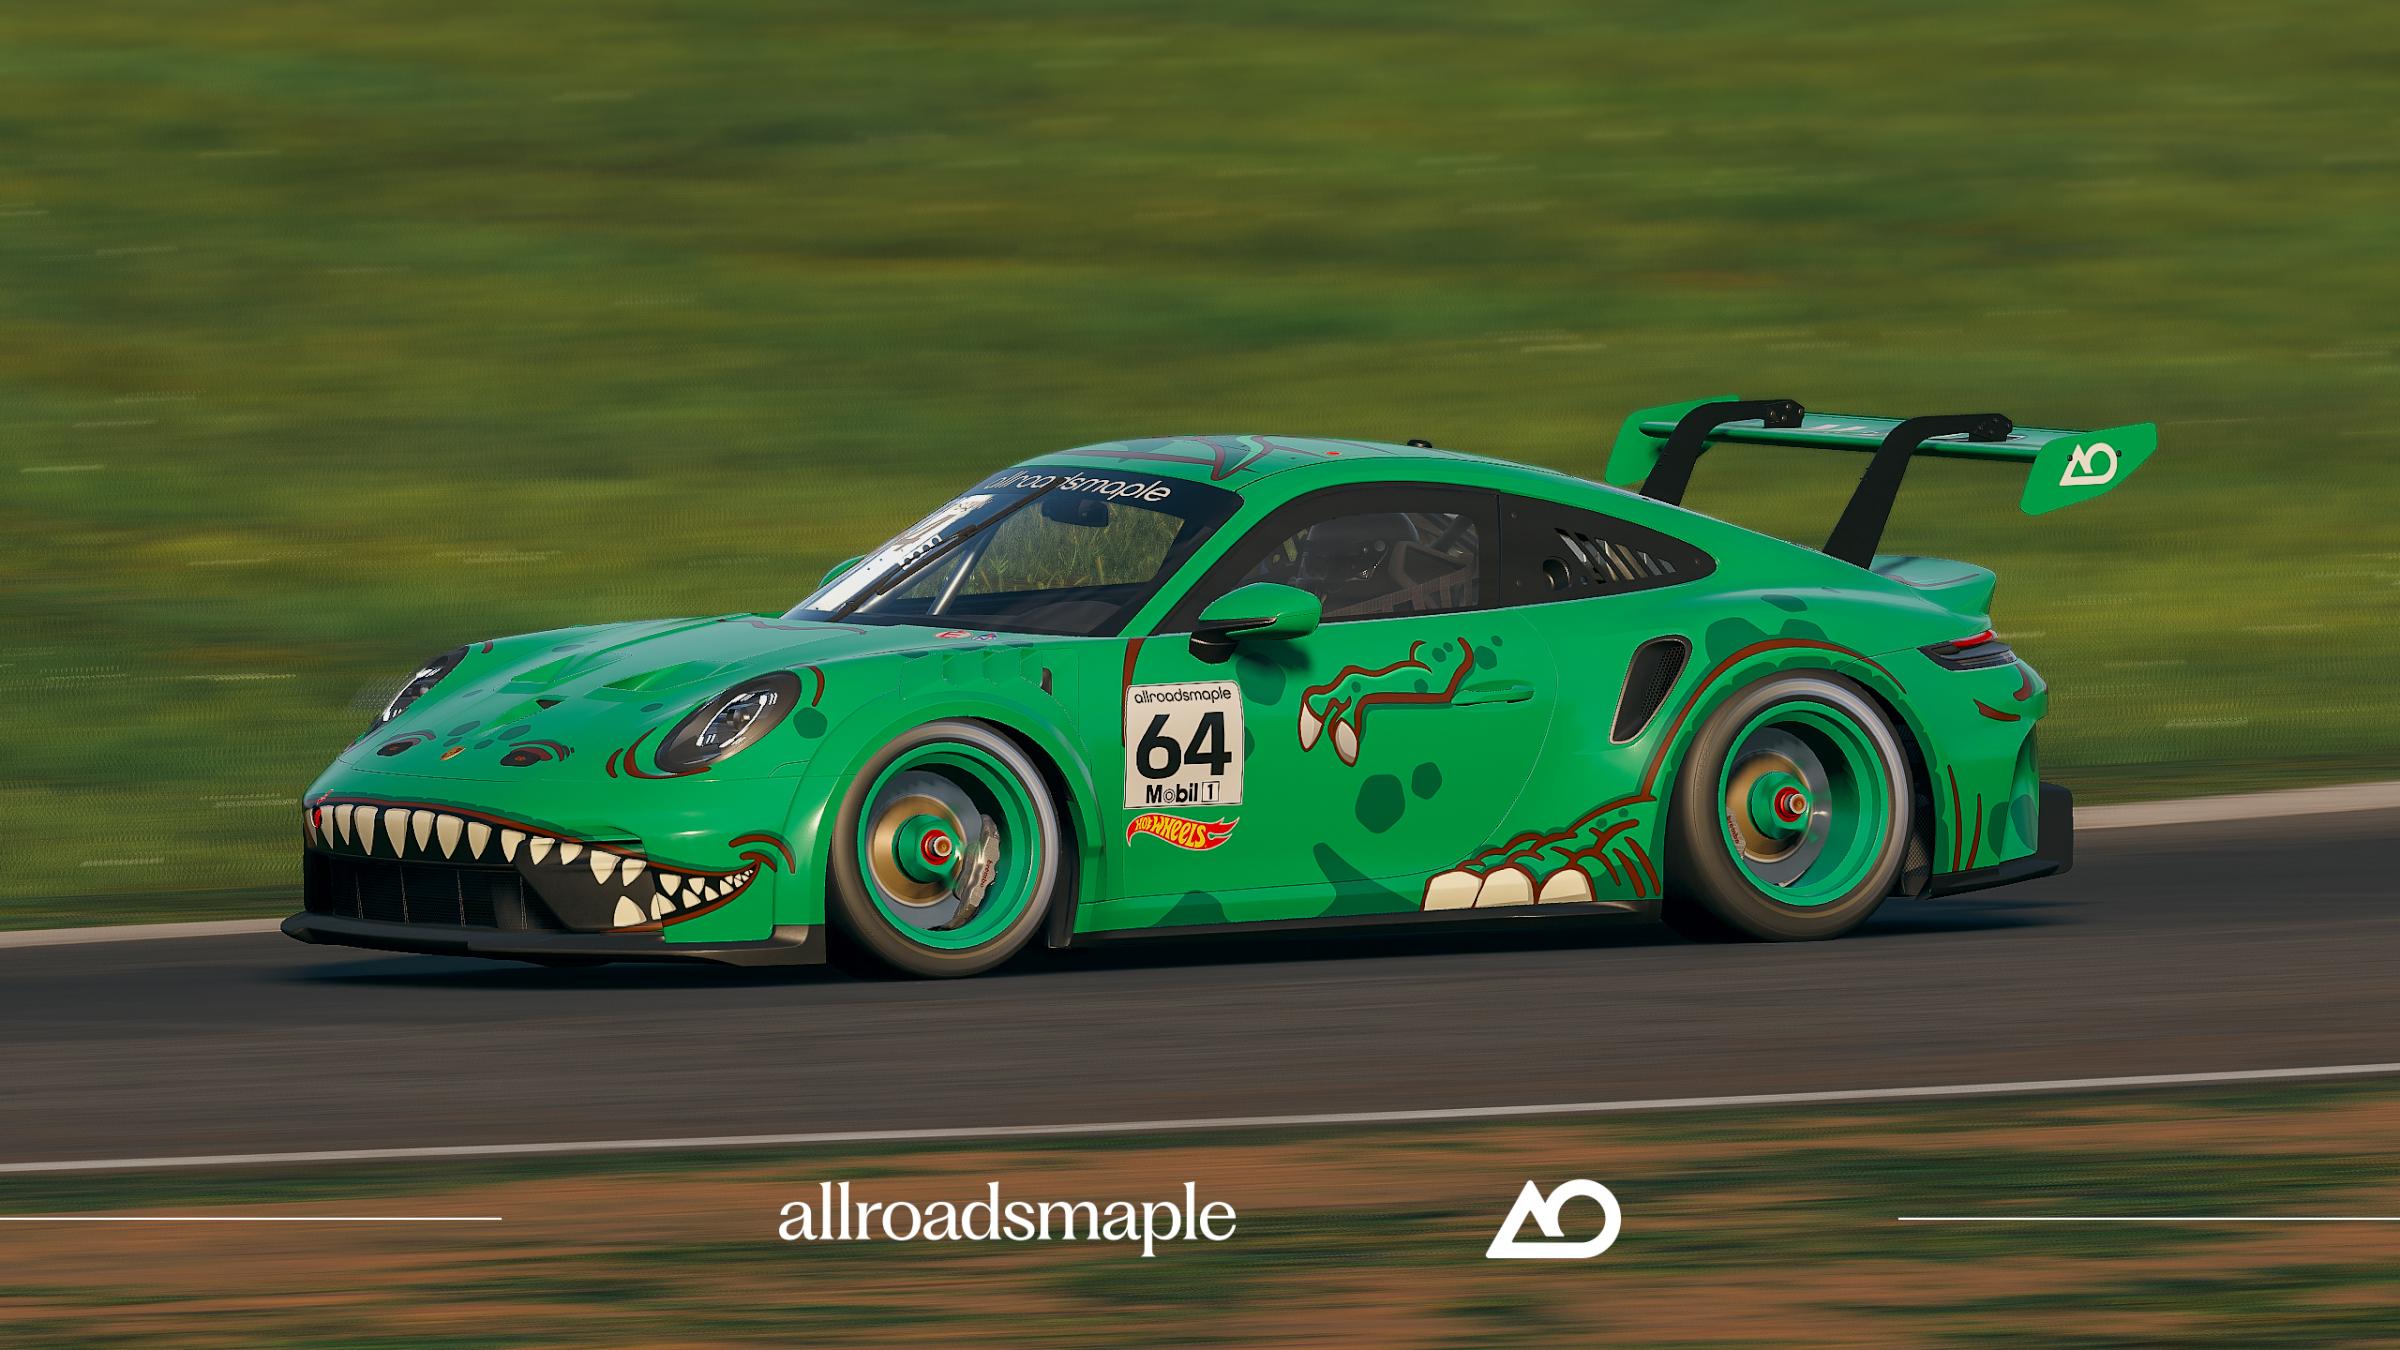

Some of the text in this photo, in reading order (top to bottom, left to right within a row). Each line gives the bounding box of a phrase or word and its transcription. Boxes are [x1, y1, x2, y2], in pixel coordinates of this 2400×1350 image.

[1134, 686, 1232, 704] allroadsmaple
[1136, 711, 1232, 780] 64
[1146, 783, 1199, 804] Mobil
[1135, 815, 1153, 832] HOT
